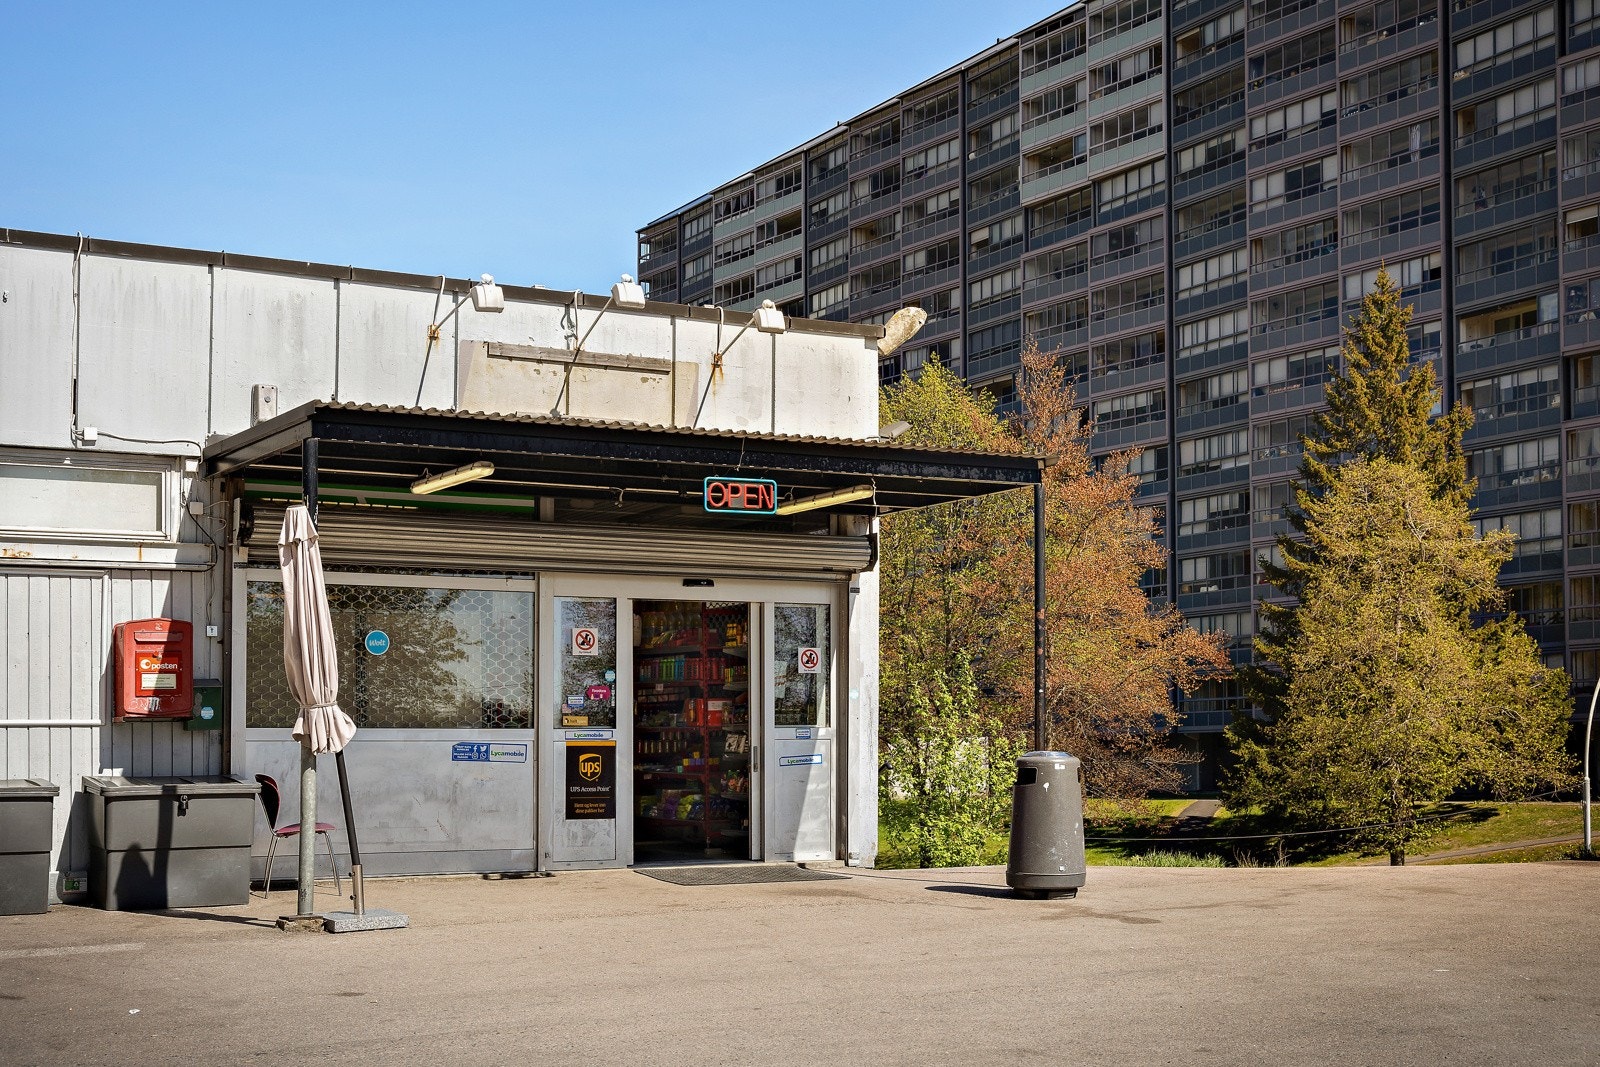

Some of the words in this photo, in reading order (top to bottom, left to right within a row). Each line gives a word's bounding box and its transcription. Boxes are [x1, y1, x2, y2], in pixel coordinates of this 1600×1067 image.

[707, 481, 774, 510] OPEN
[369, 639, 386, 647] Wolt
[151, 662, 178, 671] posten
[490, 750, 525, 758] Lycamobile
[581, 762, 600, 777] ups
